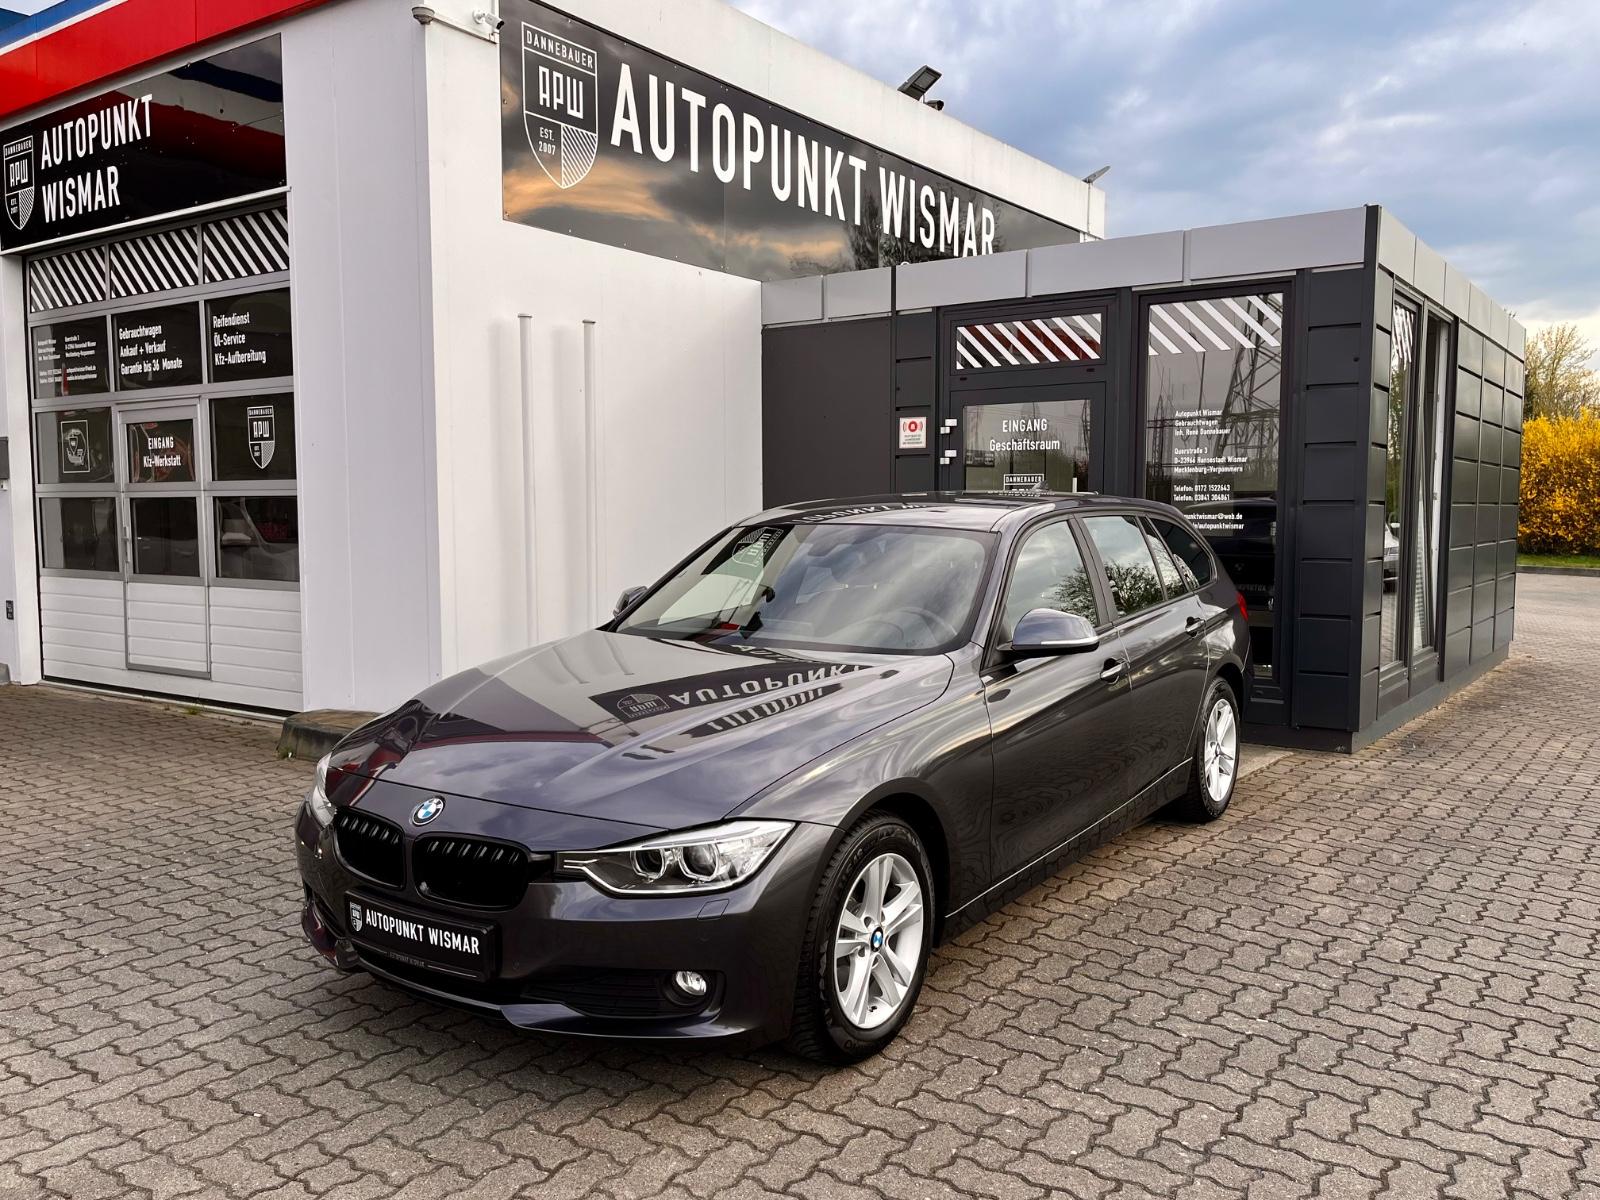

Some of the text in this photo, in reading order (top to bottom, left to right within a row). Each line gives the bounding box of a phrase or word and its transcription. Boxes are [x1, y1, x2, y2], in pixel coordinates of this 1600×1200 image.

[526, 30, 593, 69] DANNEBAUER
[538, 65, 584, 120] APW
[41, 93, 153, 170] AUTOPUNKT
[539, 126, 555, 141] EST.
[538, 140, 556, 155] 2007
[610, 62, 995, 258] AUTOPUNKT WISMAR
[9, 158, 28, 188] APW
[42, 165, 121, 224] WISMAR
[213, 312, 250, 328] Reifendienst
[119, 324, 162, 340] Gebrauchtwagen
[213, 332, 246, 347] Öl-Service
[120, 343, 138, 357] Ankauf
[145, 340, 167, 354] Verkauf
[121, 361, 143, 375] Garantie
[143, 359, 152, 373] bis
[162, 357, 183, 370] Monate
[214, 350, 267, 366] Kfz-Aufbereitung
[253, 420, 270, 438] APW
[1002, 418, 1048, 432] EINGANG
[1174, 419, 1218, 427] Gebrauchtwagen
[148, 437, 174, 450] EINGANG
[989, 438, 1061, 452] Geschäftsraum
[143, 454, 182, 468] Kfz-Werkstatt
[1194, 484, 1207, 492] 0172
[365, 908, 480, 955] AUTOPUNKT WISMAR
